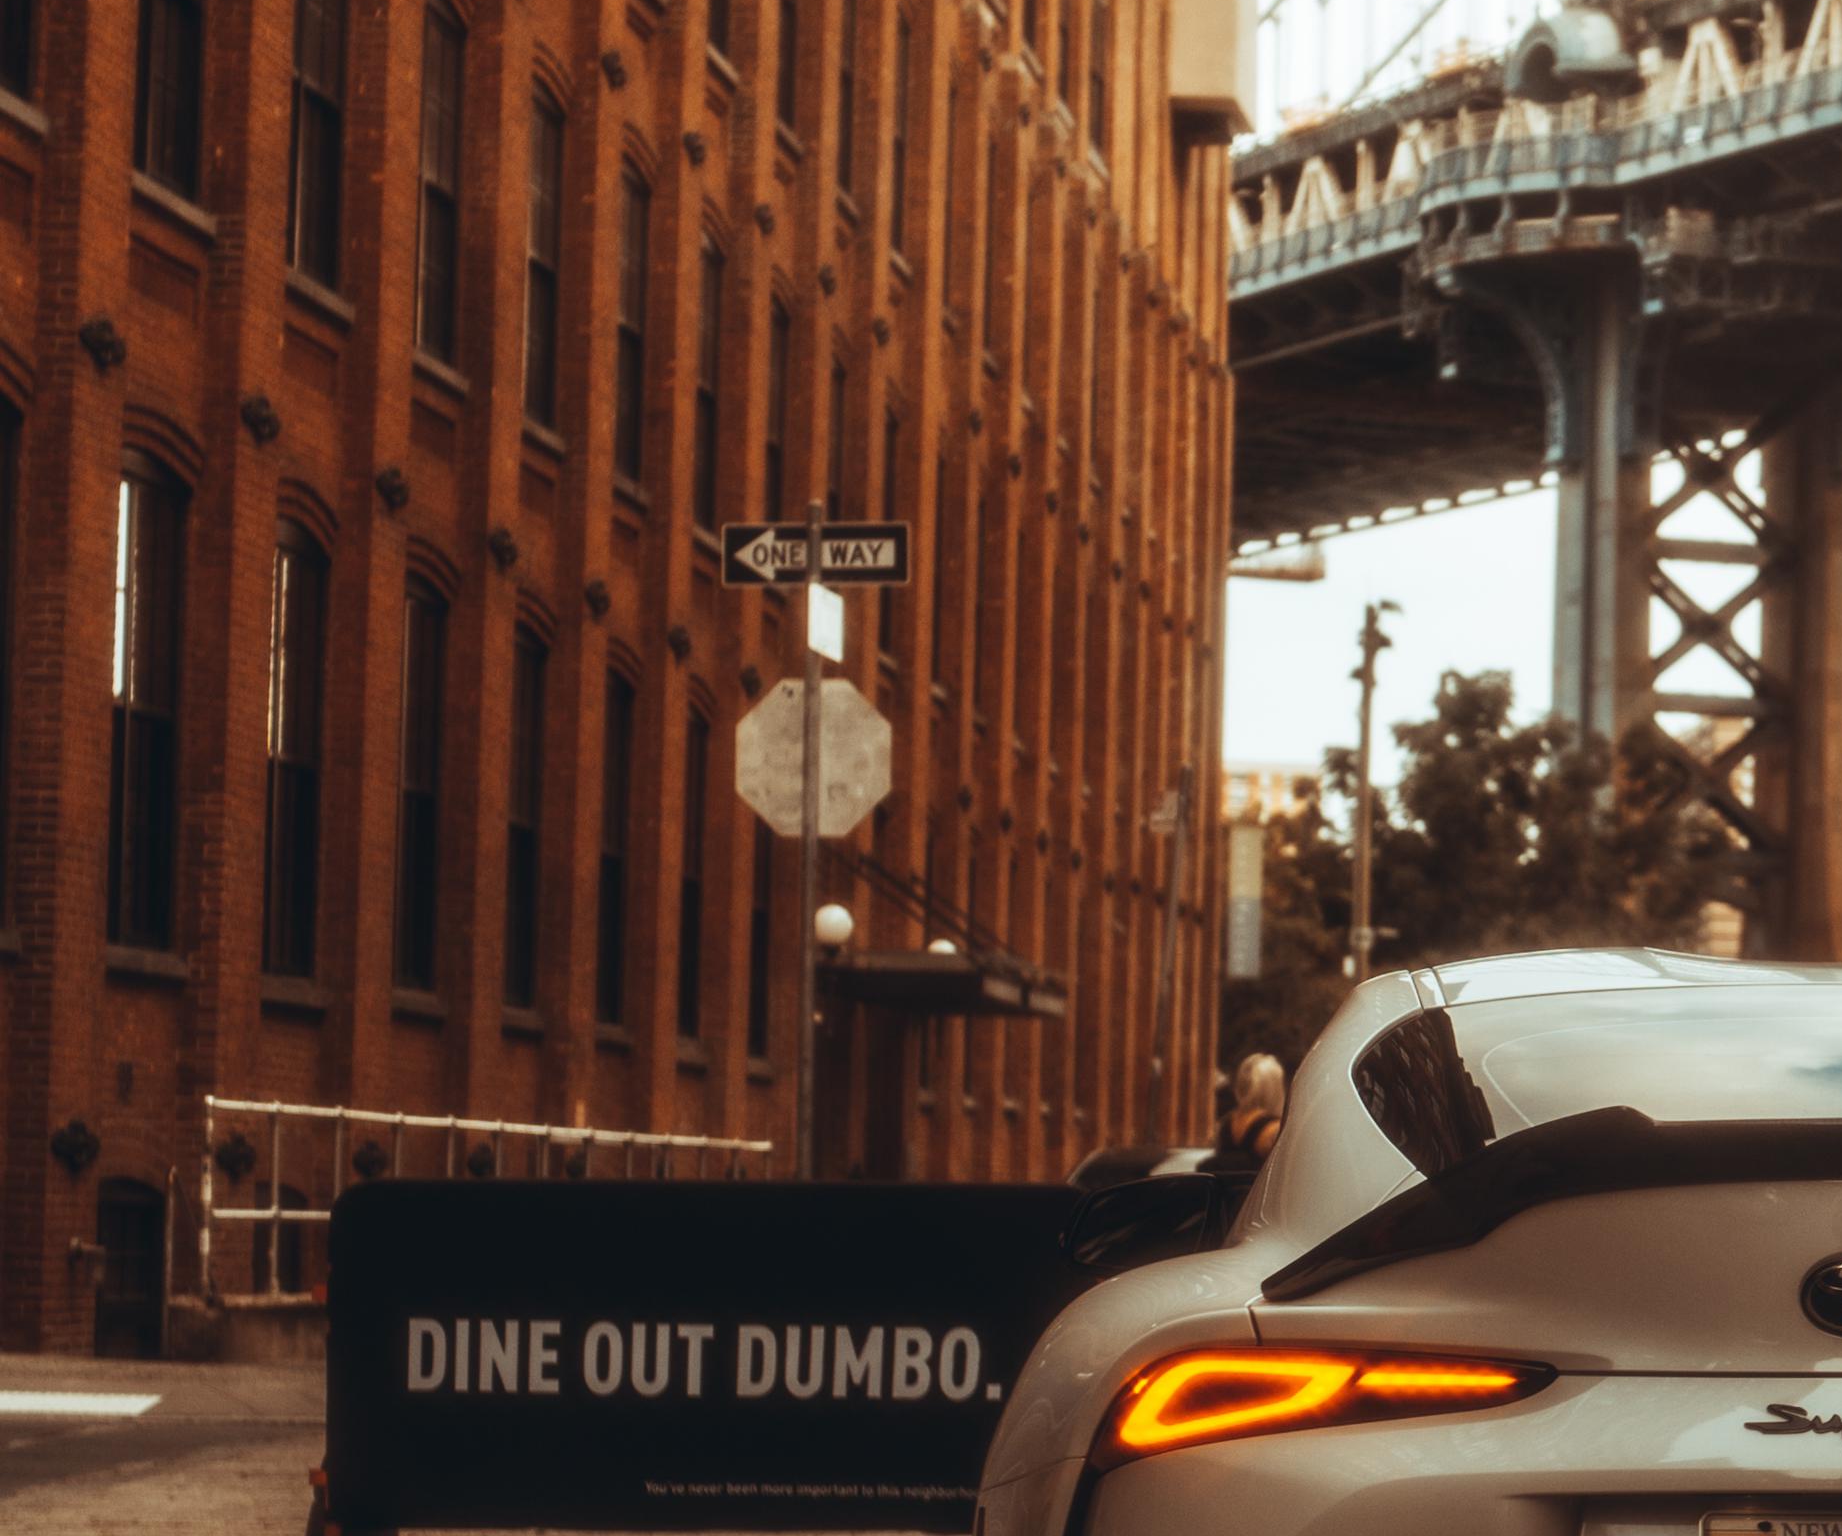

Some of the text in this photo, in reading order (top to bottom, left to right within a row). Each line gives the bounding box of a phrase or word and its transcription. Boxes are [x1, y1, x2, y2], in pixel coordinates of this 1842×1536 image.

[752, 541, 884, 566] ONE WAY
[408, 1318, 1001, 1401] DINE OUT DUMBO.
[644, 1480, 684, 1496] You've
[687, 1482, 723, 1497] never
[726, 1481, 757, 1497] been
[760, 1483, 793, 1497] more
[796, 1482, 857, 1500] important
[861, 1483, 874, 1498] to
[877, 1483, 900, 1498] this
